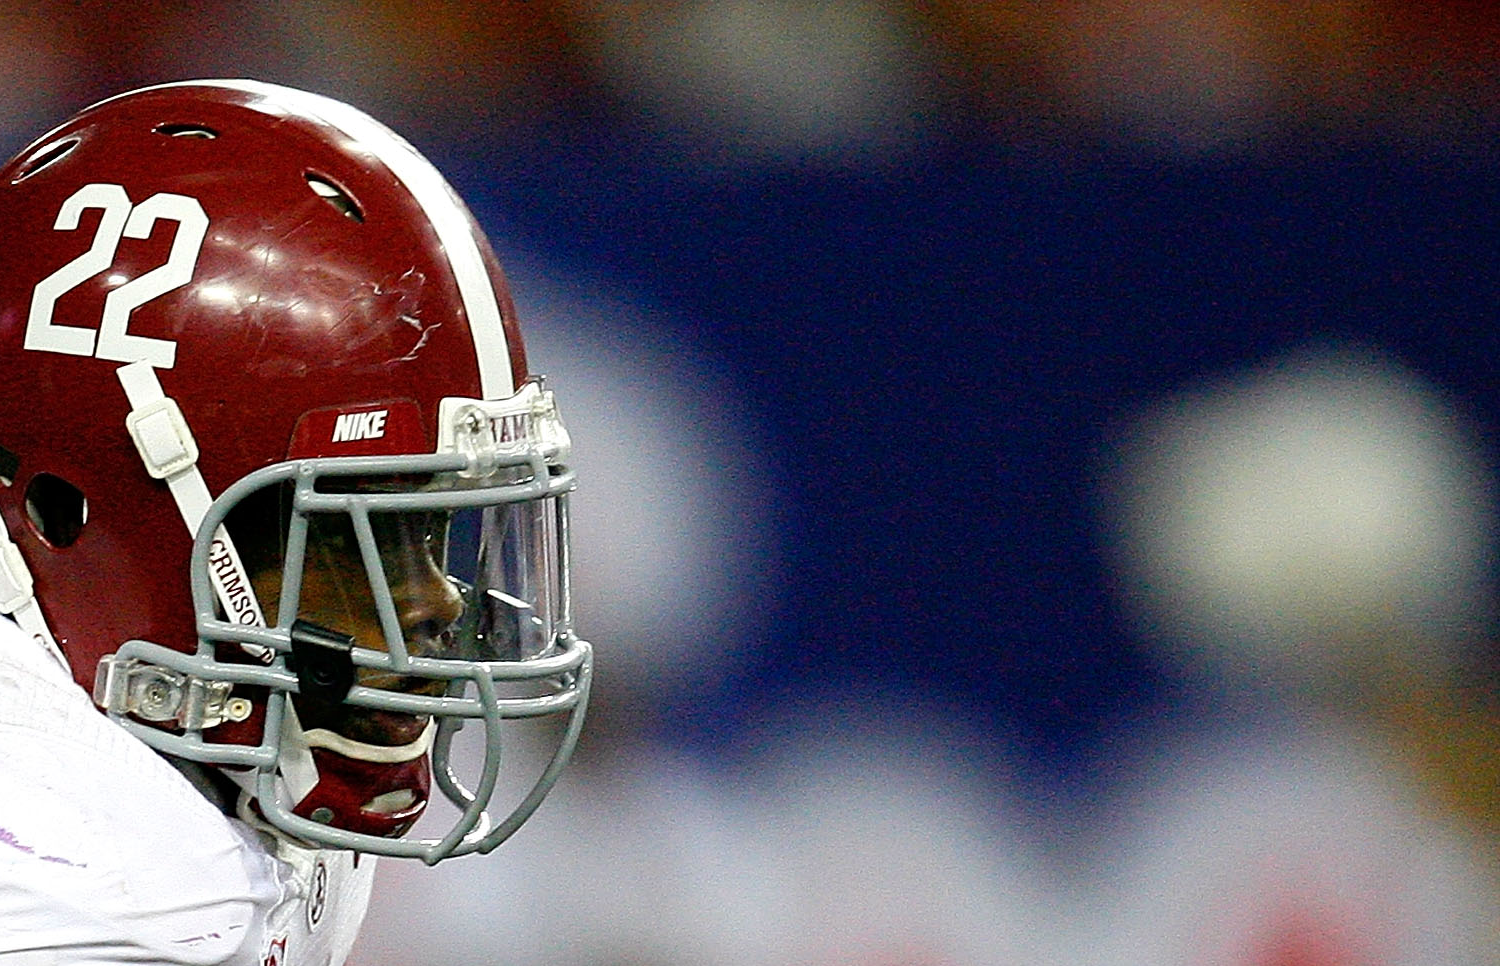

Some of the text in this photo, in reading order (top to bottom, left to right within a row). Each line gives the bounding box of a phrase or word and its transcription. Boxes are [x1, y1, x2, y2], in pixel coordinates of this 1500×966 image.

[24, 183, 210, 369] 22
[332, 410, 388, 442] NIKE
[209, 539, 261, 627] CRIMSO
